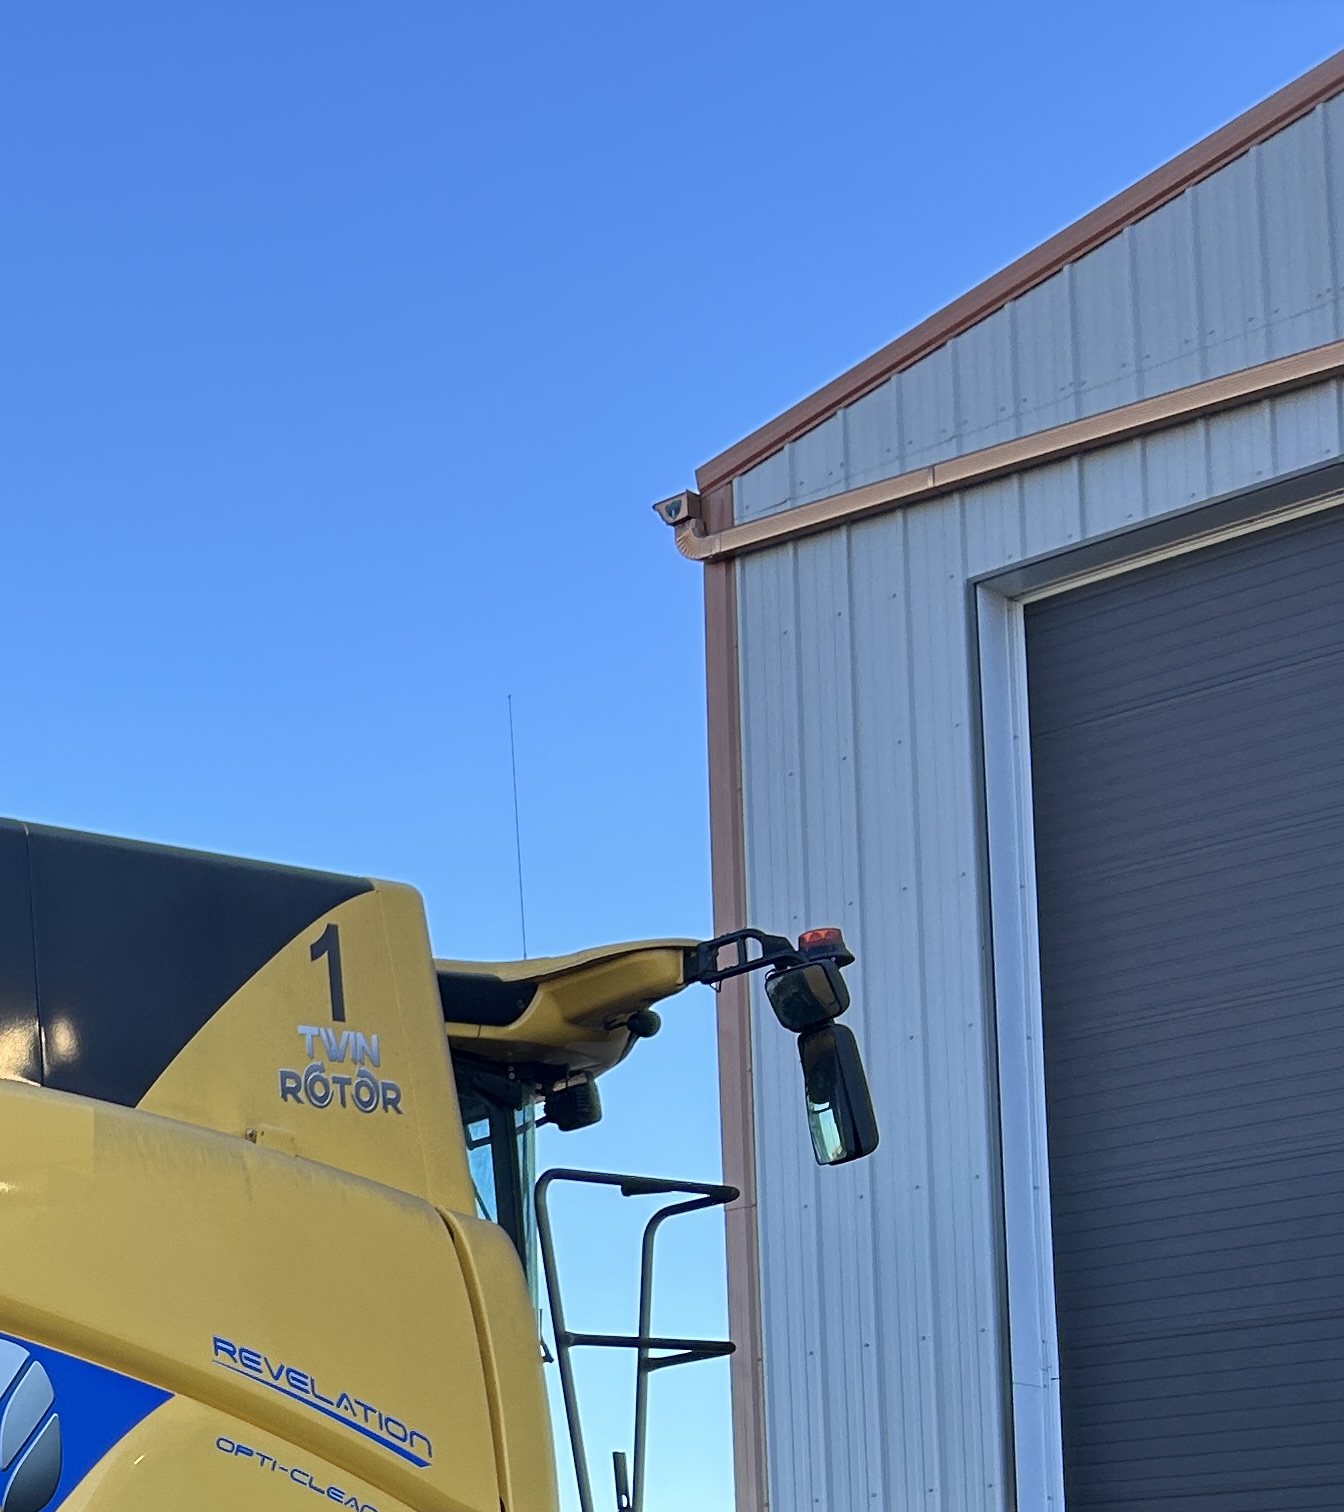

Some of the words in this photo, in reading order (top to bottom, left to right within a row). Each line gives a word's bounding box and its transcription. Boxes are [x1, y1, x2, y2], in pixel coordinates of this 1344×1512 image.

[310, 923, 346, 1022] 1
[298, 1024, 381, 1067] TWIN
[279, 1061, 404, 1114] ROTOR
[213, 1335, 433, 1459] REVELATION
